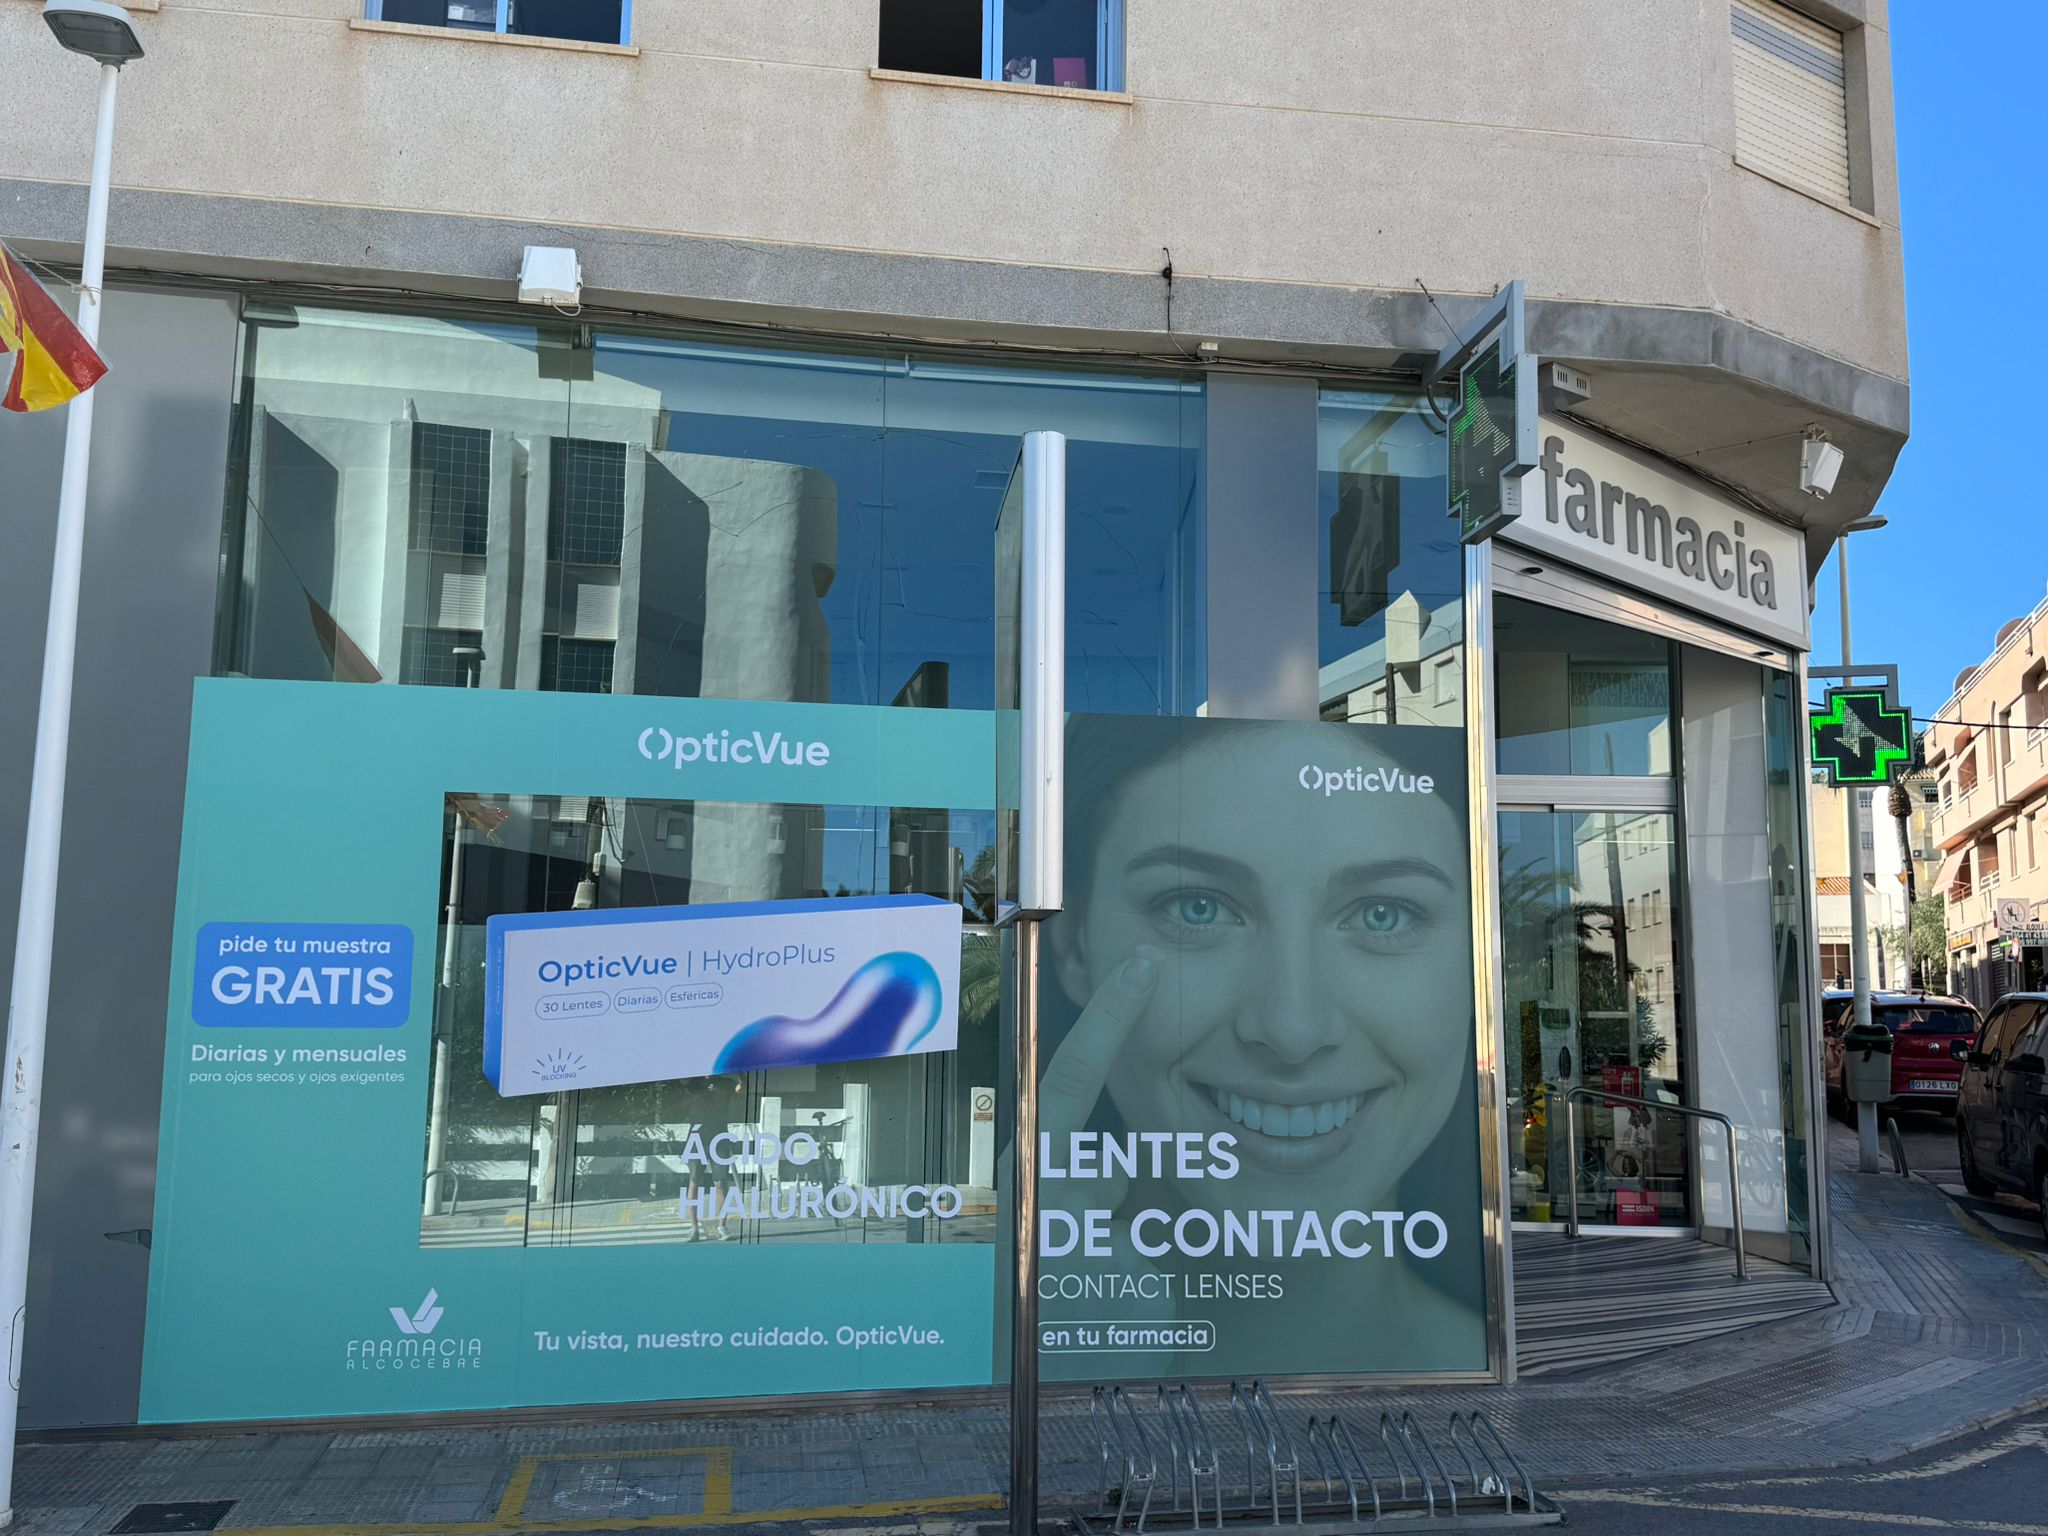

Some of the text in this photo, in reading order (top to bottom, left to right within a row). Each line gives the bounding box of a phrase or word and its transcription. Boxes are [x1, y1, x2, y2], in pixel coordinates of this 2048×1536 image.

[1539, 435, 1777, 610] farmacia
[638, 727, 830, 770] OpticVue
[1299, 765, 1434, 797] OpticVue
[219, 935, 391, 956] pide tu muestra
[538, 954, 678, 987] OpticVue
[702, 943, 836, 975] HydroPlus
[211, 965, 394, 1006] GRATIS
[670, 988, 719, 1003] Esféricas
[543, 998, 604, 1014] 30 Lentes
[617, 994, 659, 1008] Diarias
[191, 1044, 407, 1066] Diarias y mensuales
[189, 1070, 405, 1085] para ojos secos y ojos exigentes
[541, 1072, 577, 1081] BLOCKING
[552, 1064, 567, 1074] UV
[1916, 1081, 1937, 1090] 0126
[680, 1124, 818, 1166] ÁCIDO
[1039, 1131, 1240, 1180] LENTES
[678, 1176, 963, 1220] HIALURÓNICO
[1039, 1208, 1448, 1259] DE CONTACTO
[1038, 1274, 1284, 1300] CONTACT LENSES
[534, 1325, 945, 1352] Tu vista, nuestro cuidado. OpticVue.
[1042, 1325, 1208, 1347] en tu farmacia
[346, 1338, 481, 1357] FARMACIA
[346, 1357, 481, 1370] ALCOCEBRE
